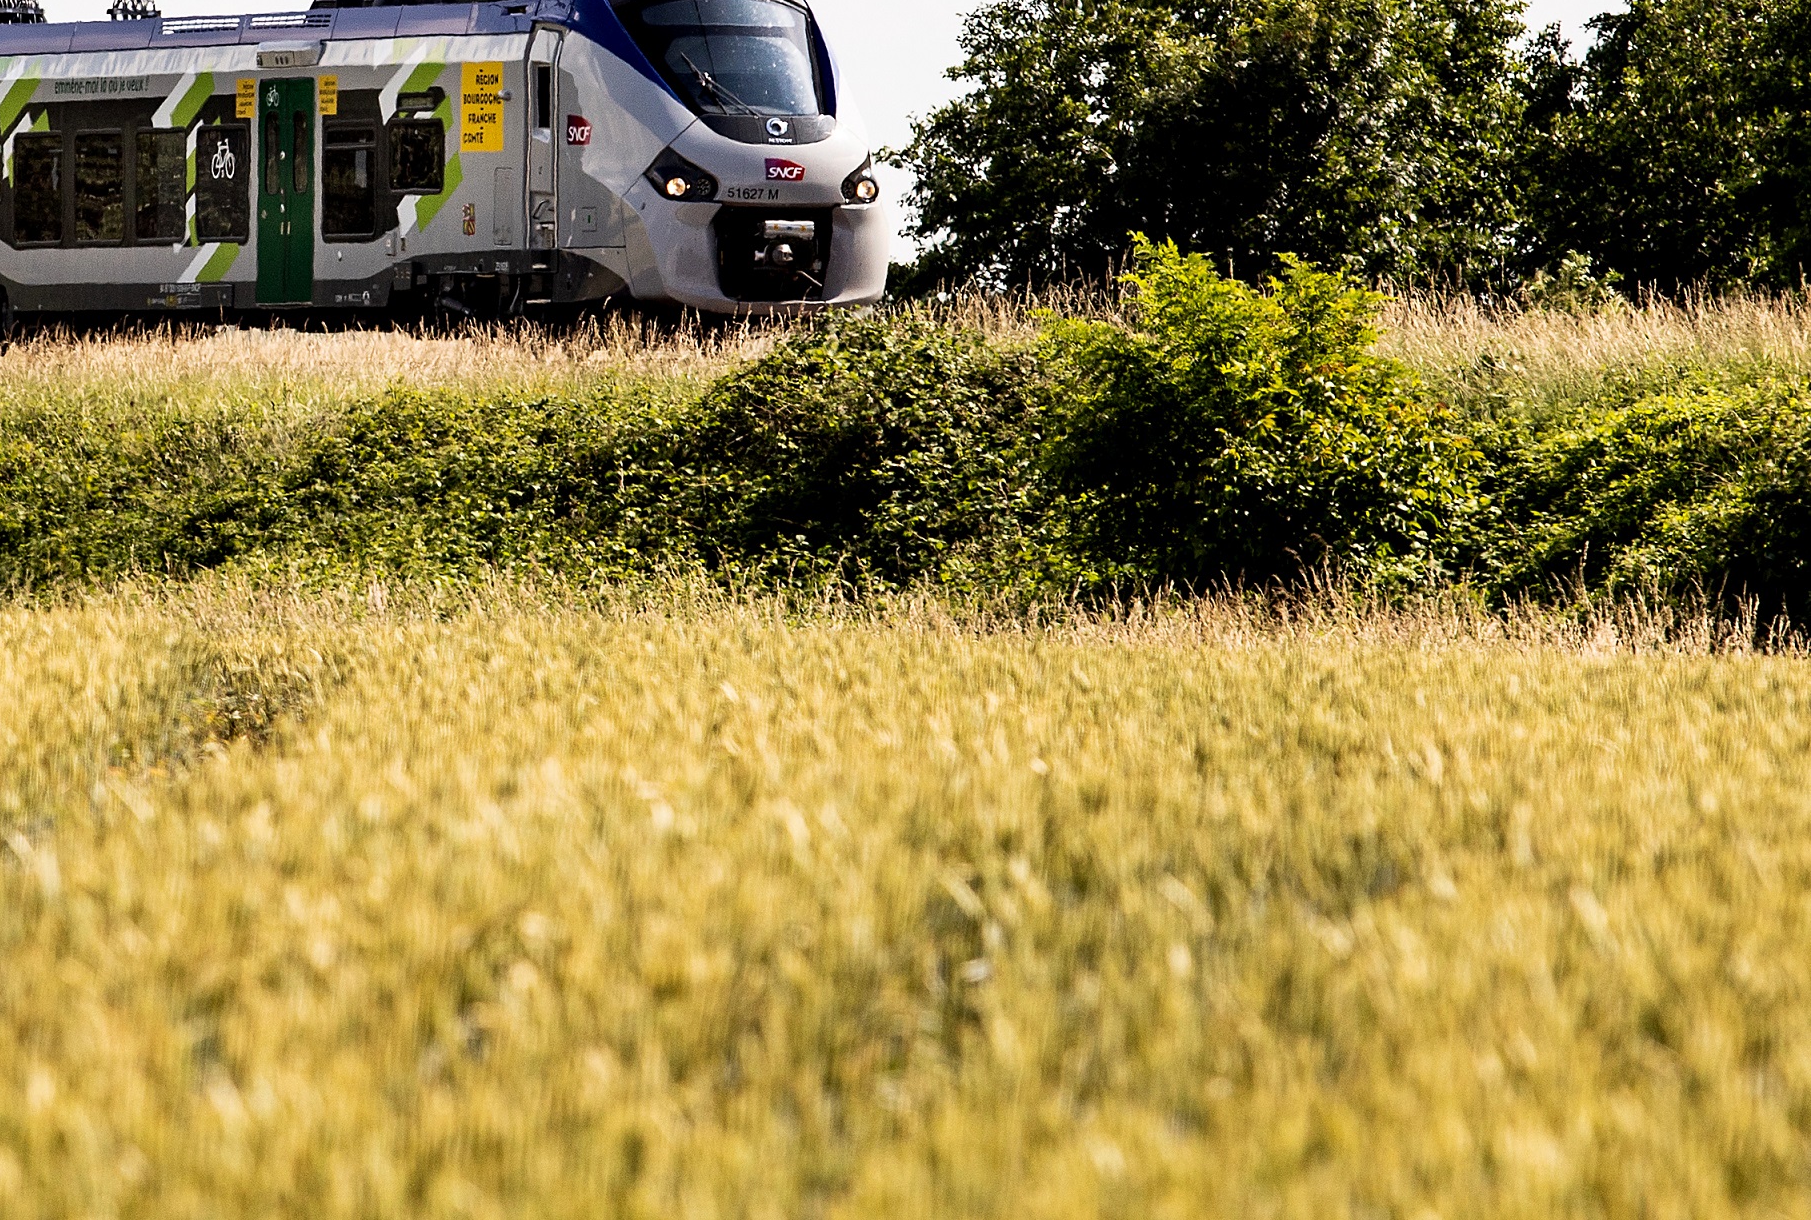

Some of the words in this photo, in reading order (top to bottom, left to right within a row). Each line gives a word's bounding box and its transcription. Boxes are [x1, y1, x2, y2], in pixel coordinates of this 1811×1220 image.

[468, 113, 497, 124] FRANCHE
[568, 126, 591, 141] SNCF
[768, 167, 803, 179] SNCF
[728, 188, 764, 200] 51627
[768, 189, 779, 200] M
